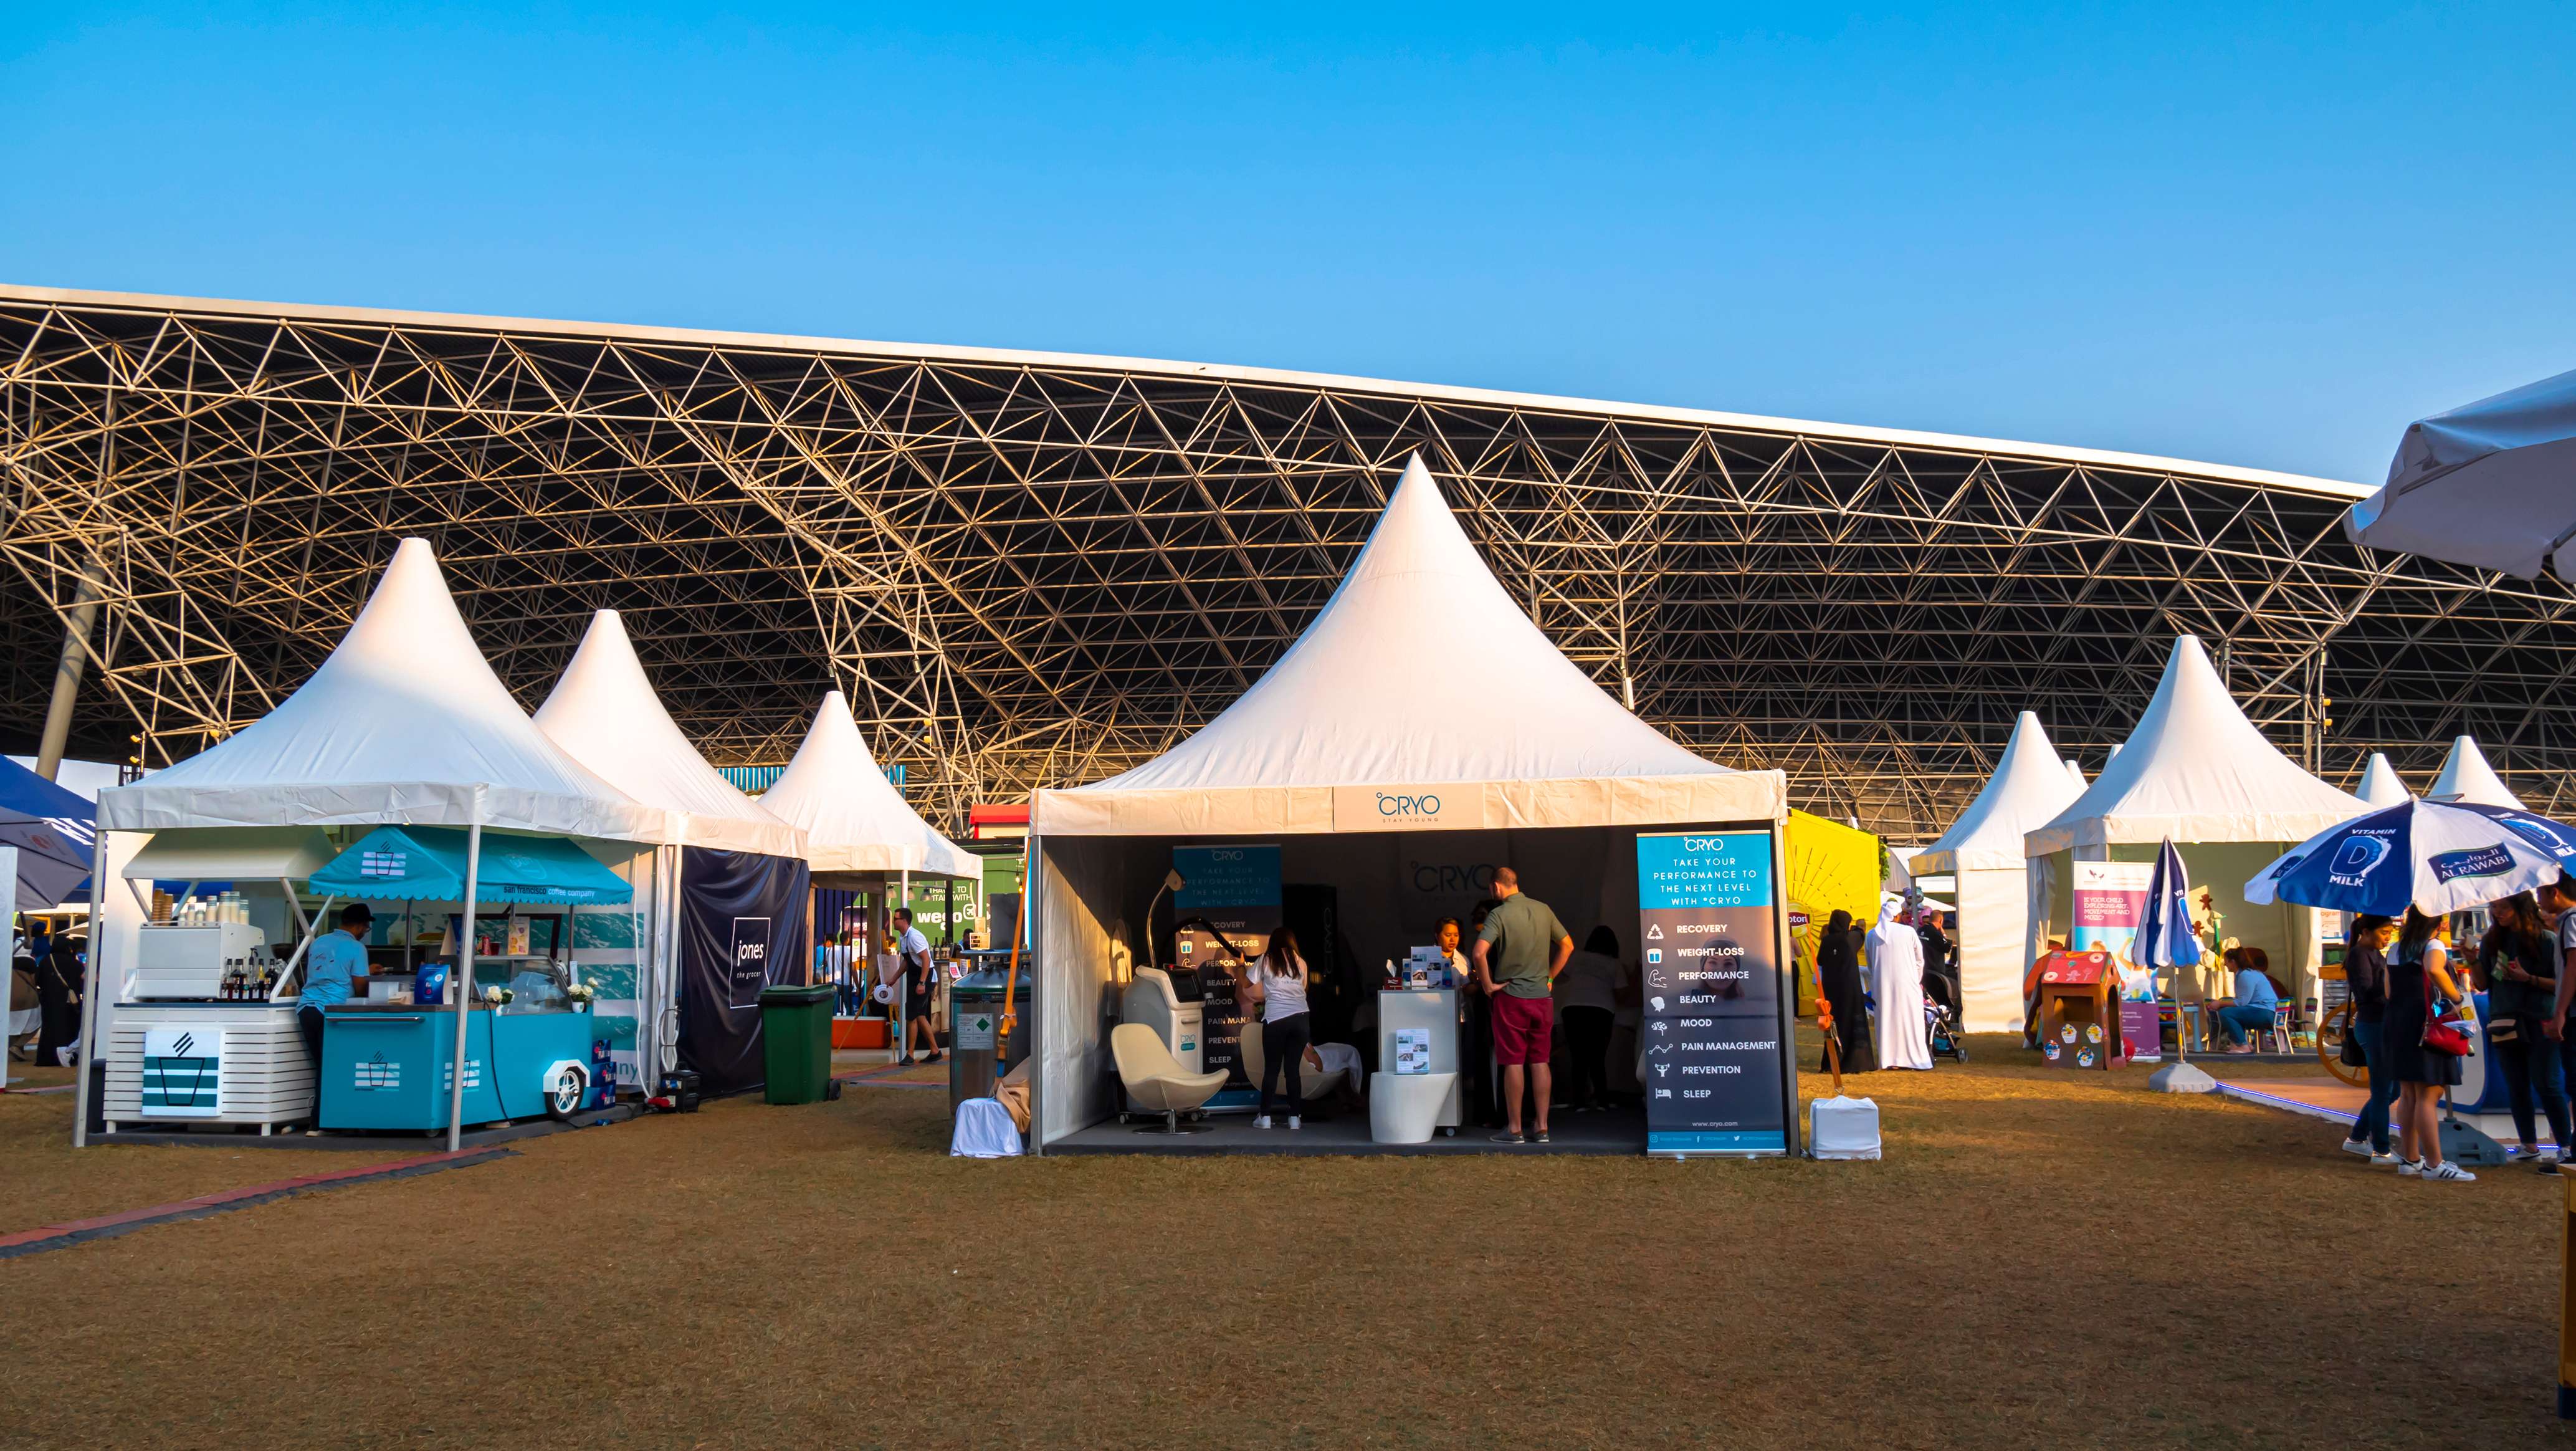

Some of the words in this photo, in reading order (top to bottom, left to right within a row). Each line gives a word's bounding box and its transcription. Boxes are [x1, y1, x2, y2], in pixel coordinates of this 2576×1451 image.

[2441, 869, 2459, 879] AL
[2459, 855, 2509, 874] RAWABI
[1653, 870, 1736, 880] PERFORMANCE
[2329, 874, 2365, 886] MILK
[503, 885, 515, 893] san
[517, 885, 546, 894] francisco
[568, 889, 595, 898] company
[1686, 884, 1712, 892] NEXT
[1719, 883, 1751, 891] LEVEL
[1671, 898, 1697, 906] WITH
[1676, 924, 1727, 933] RECOVERY
[737, 939, 764, 967] jones
[1677, 947, 1744, 957] WEIGHT-LOSS
[746, 971, 761, 980] grocer
[1679, 971, 1749, 980] PERFORMANCE
[1679, 995, 1716, 1003] BEAUTY
[1681, 1018, 1712, 1027] MOOD
[1682, 1043, 1704, 1051] PAIN
[1706, 1042, 1776, 1050] MANAGEMENT
[1682, 1066, 1741, 1075] PREVENTION
[1683, 1090, 1711, 1098] SLEEP
